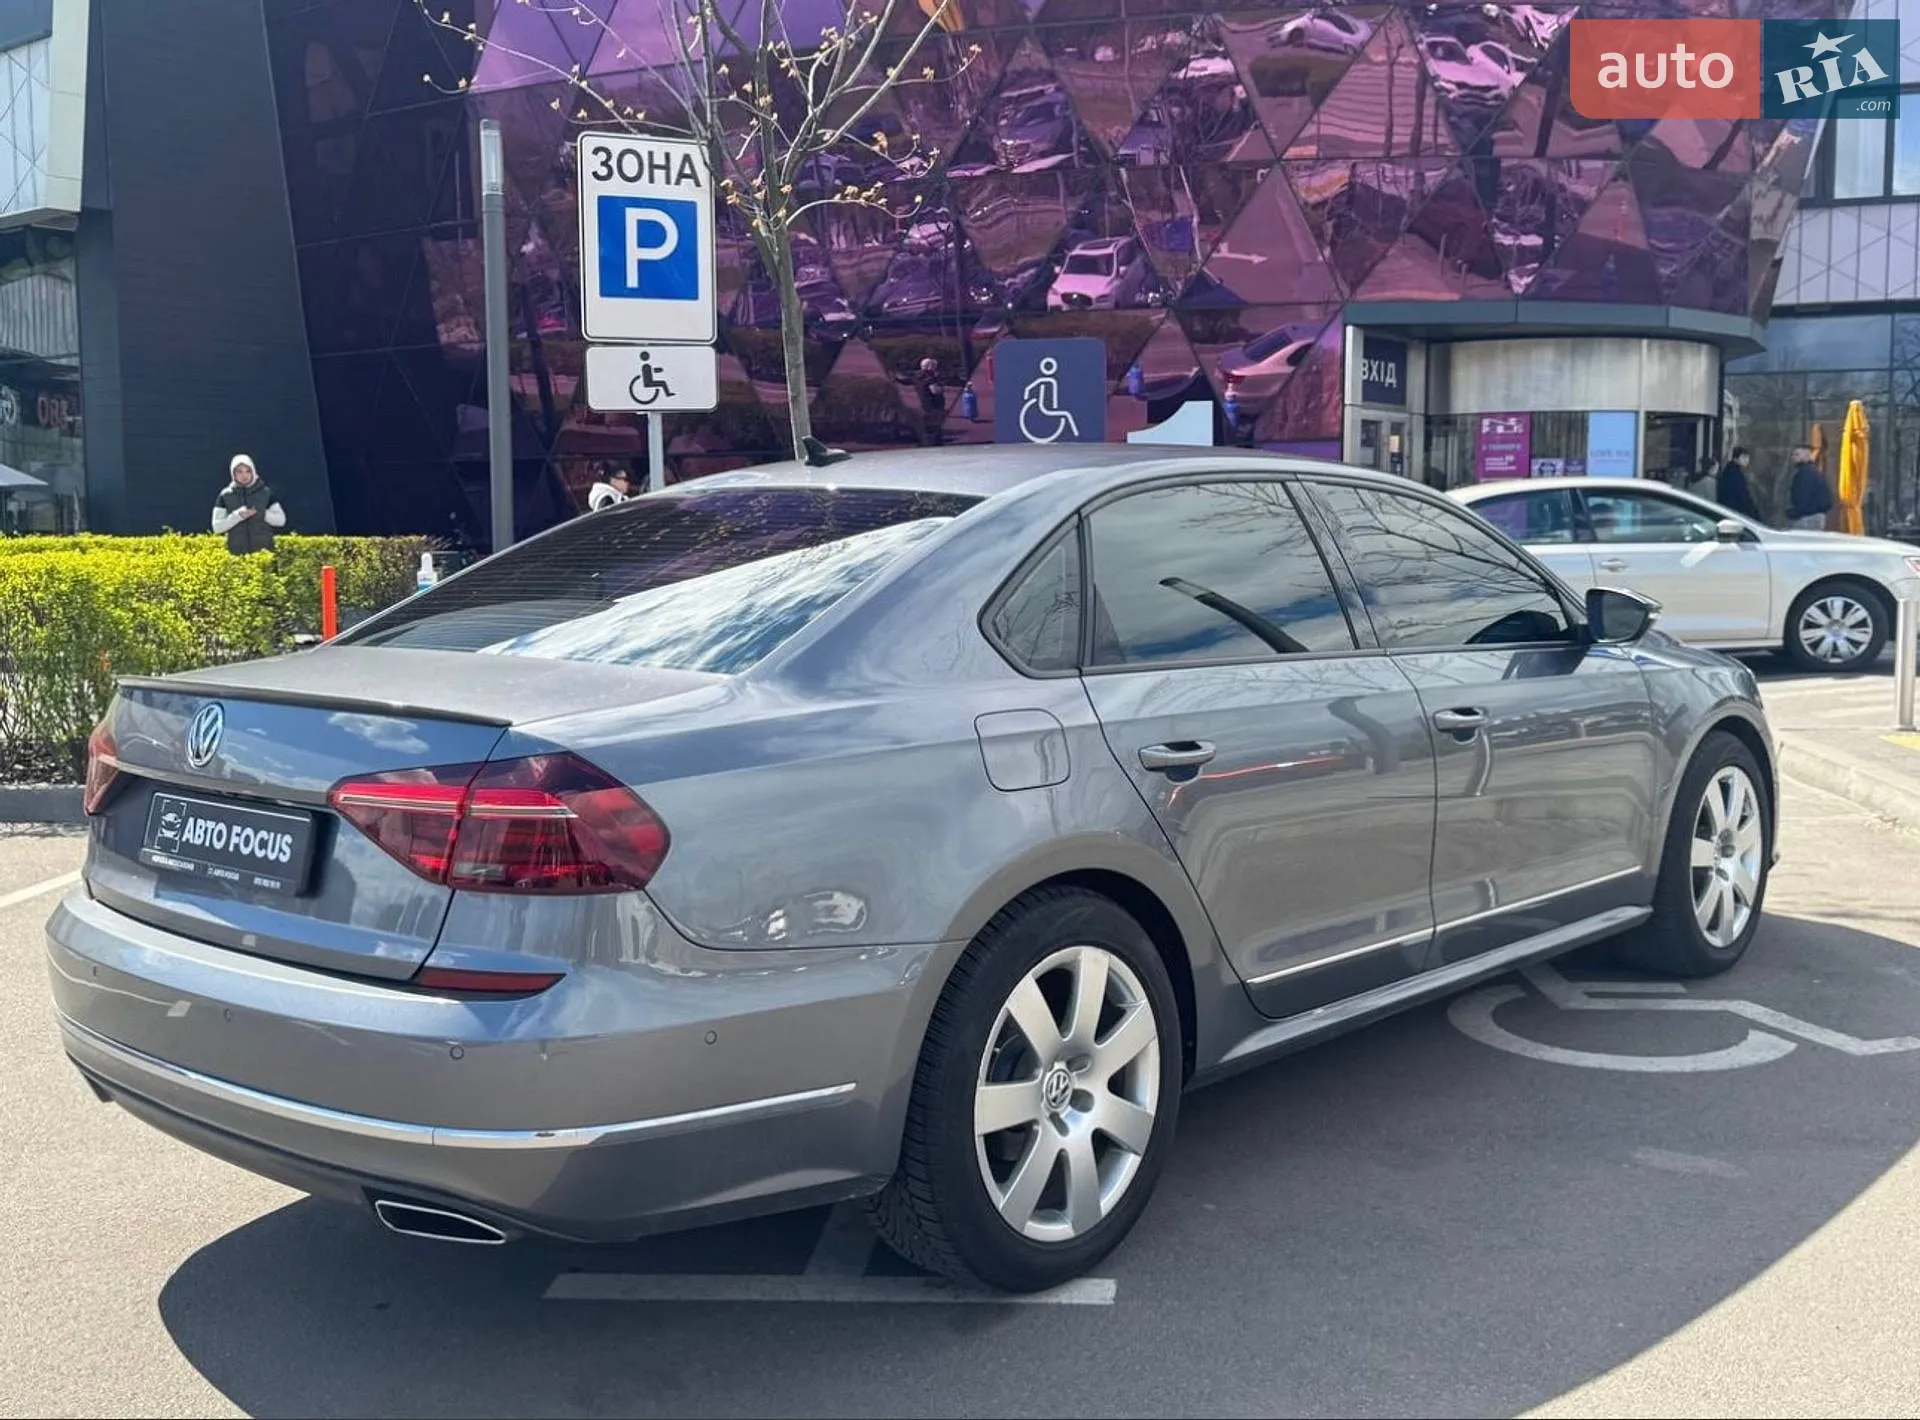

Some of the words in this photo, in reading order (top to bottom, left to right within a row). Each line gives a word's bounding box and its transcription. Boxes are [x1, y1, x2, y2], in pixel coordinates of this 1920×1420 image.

[591, 146, 701, 187] ЗОНА
[625, 207, 679, 288] P
[182, 817, 227, 849] АВТО
[229, 825, 293, 863] FOCUS
